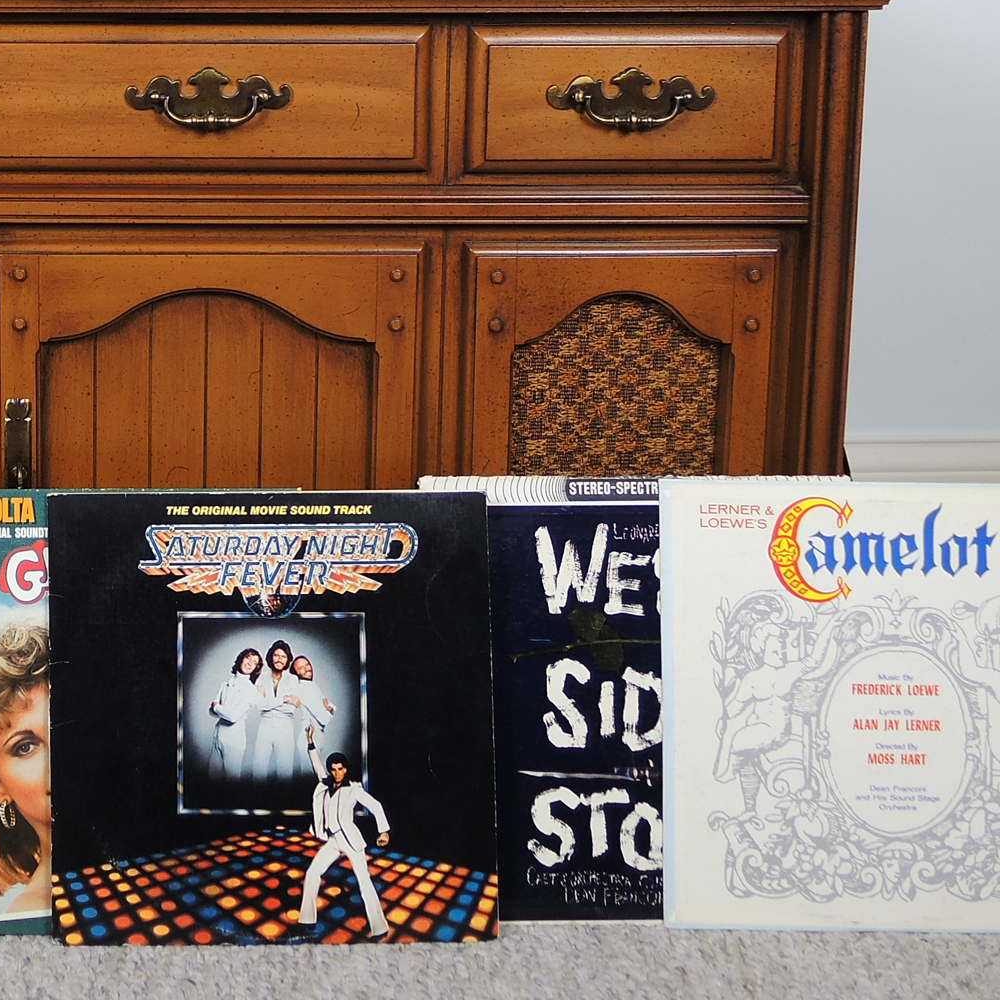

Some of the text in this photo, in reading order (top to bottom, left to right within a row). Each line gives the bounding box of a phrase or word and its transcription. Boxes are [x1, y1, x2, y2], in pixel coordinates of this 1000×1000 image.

[568, 480, 659, 495] STEREO-SPECTR
[166, 505, 373, 516] THE ORIGINAL MOVIE SOUND TRACK
[699, 504, 776, 517] LERNER &
[699, 518, 768, 530] LOEWE'S
[142, 525, 410, 564] SATURDAY NIGHT
[769, 496, 998, 603] Camelot
[217, 559, 333, 590] FEVER
[535, 522, 661, 616] WE
[878, 673, 913, 682] Music By
[852, 683, 940, 697] FREDERICK LOEWE
[878, 708, 914, 717] Lyrics By
[852, 719, 941, 732] ALAN JAY LERNER
[875, 742, 918, 752] Directed By
[868, 753, 927, 765] MOSS HART
[917, 794, 941, 803] Stage
[878, 803, 917, 811] Orchestra
